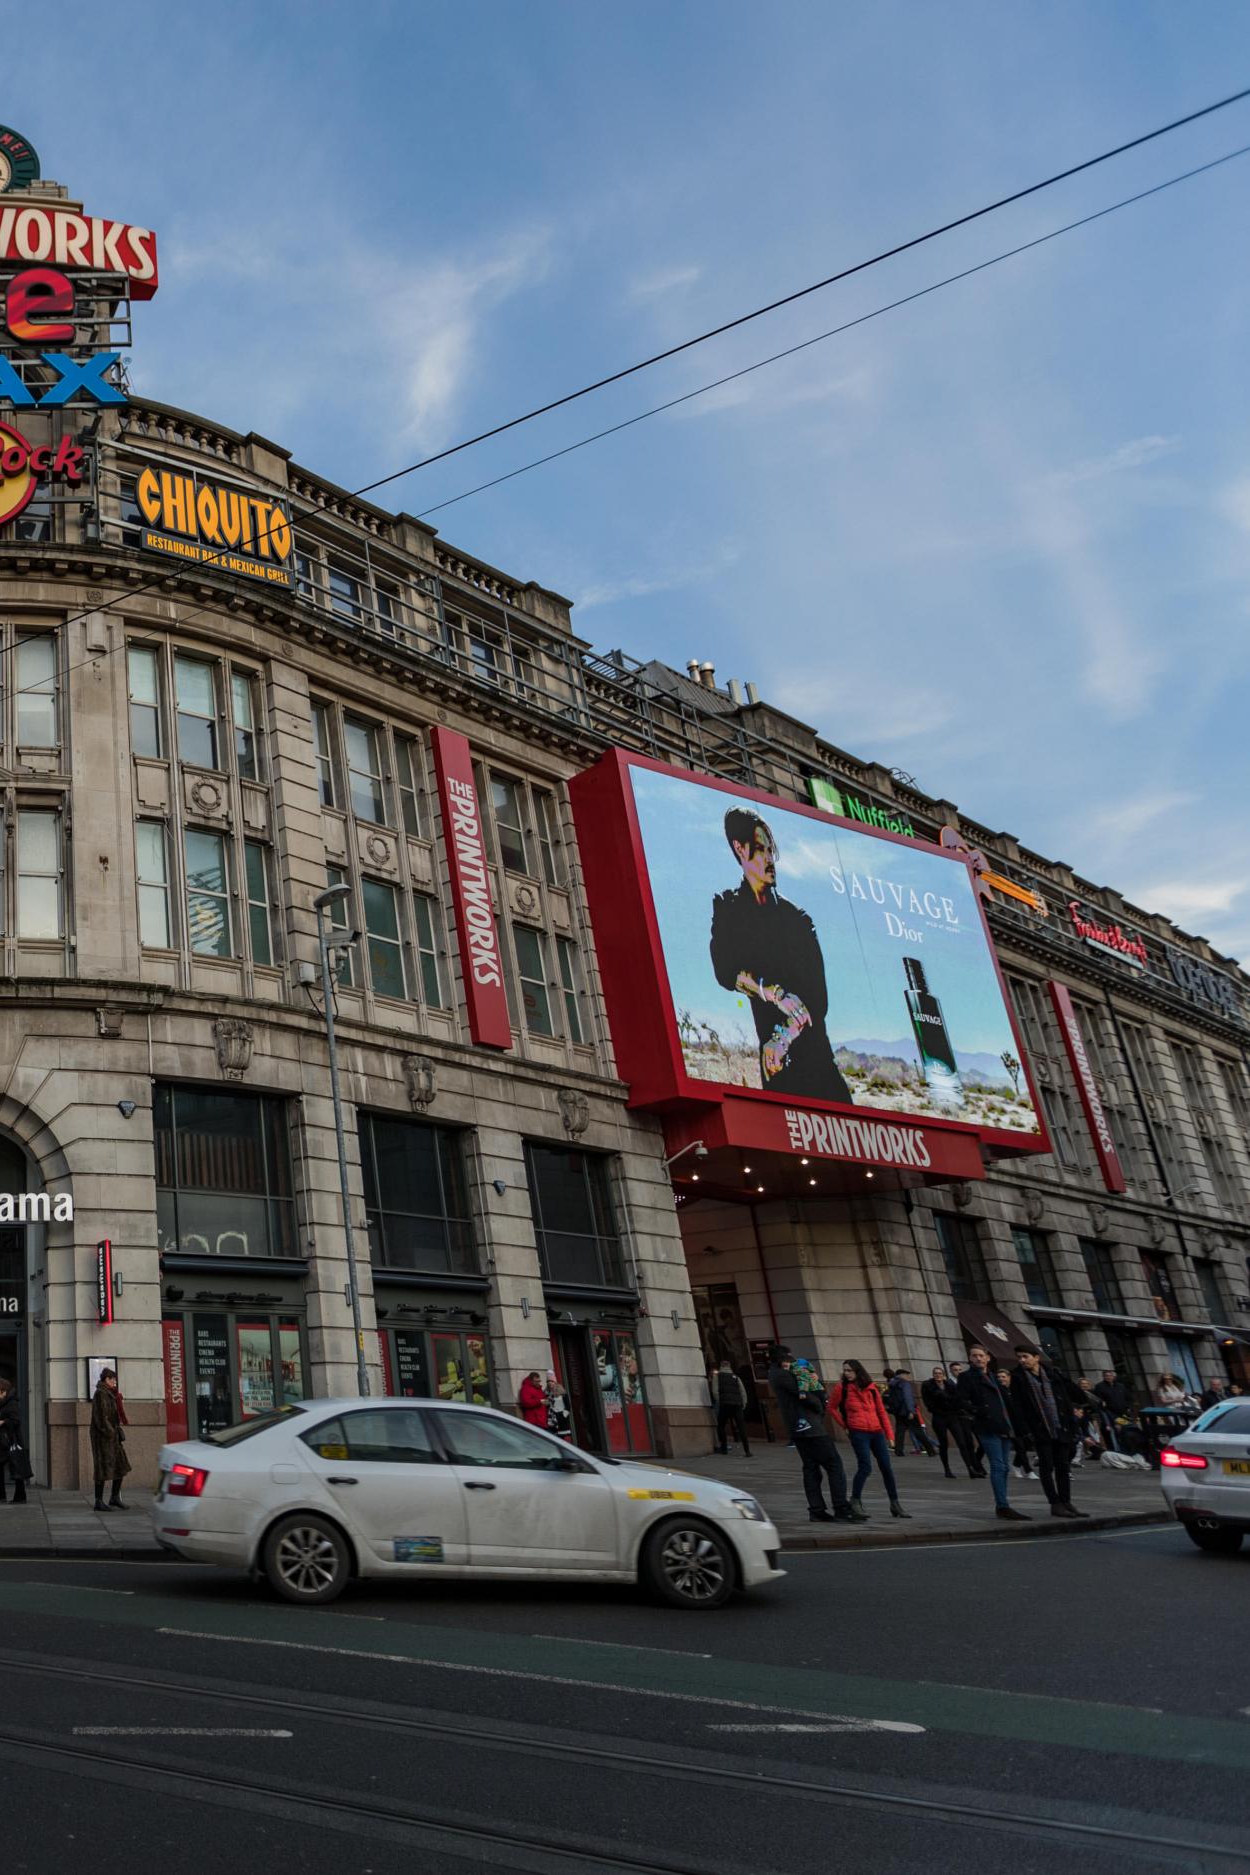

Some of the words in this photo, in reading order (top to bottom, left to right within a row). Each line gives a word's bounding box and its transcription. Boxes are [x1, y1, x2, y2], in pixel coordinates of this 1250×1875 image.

[137, 466, 292, 561] CHIQUITO
[147, 533, 201, 560] RESTAURANT
[202, 549, 219, 566] BAR
[221, 554, 228, 567] &
[229, 557, 265, 579] MEXICAN
[267, 568, 290, 585] GRILL
[447, 776, 473, 800] THE
[846, 793, 915, 839] Nuffield
[449, 794, 500, 987] PRINTWORKS
[830, 865, 959, 924] SAUVAGE
[883, 911, 924, 943] Dior
[784, 1109, 804, 1149] THE
[798, 1112, 931, 1167] PRINTWORKS
[198, 1339, 227, 1348] RESTAURANTS
[199, 1358, 214, 1366] HEALTH
[215, 1358, 226, 1366] CLUB
[169, 1335, 183, 1404] PRINTWORKS
[199, 1367, 216, 1375] EVENTS
